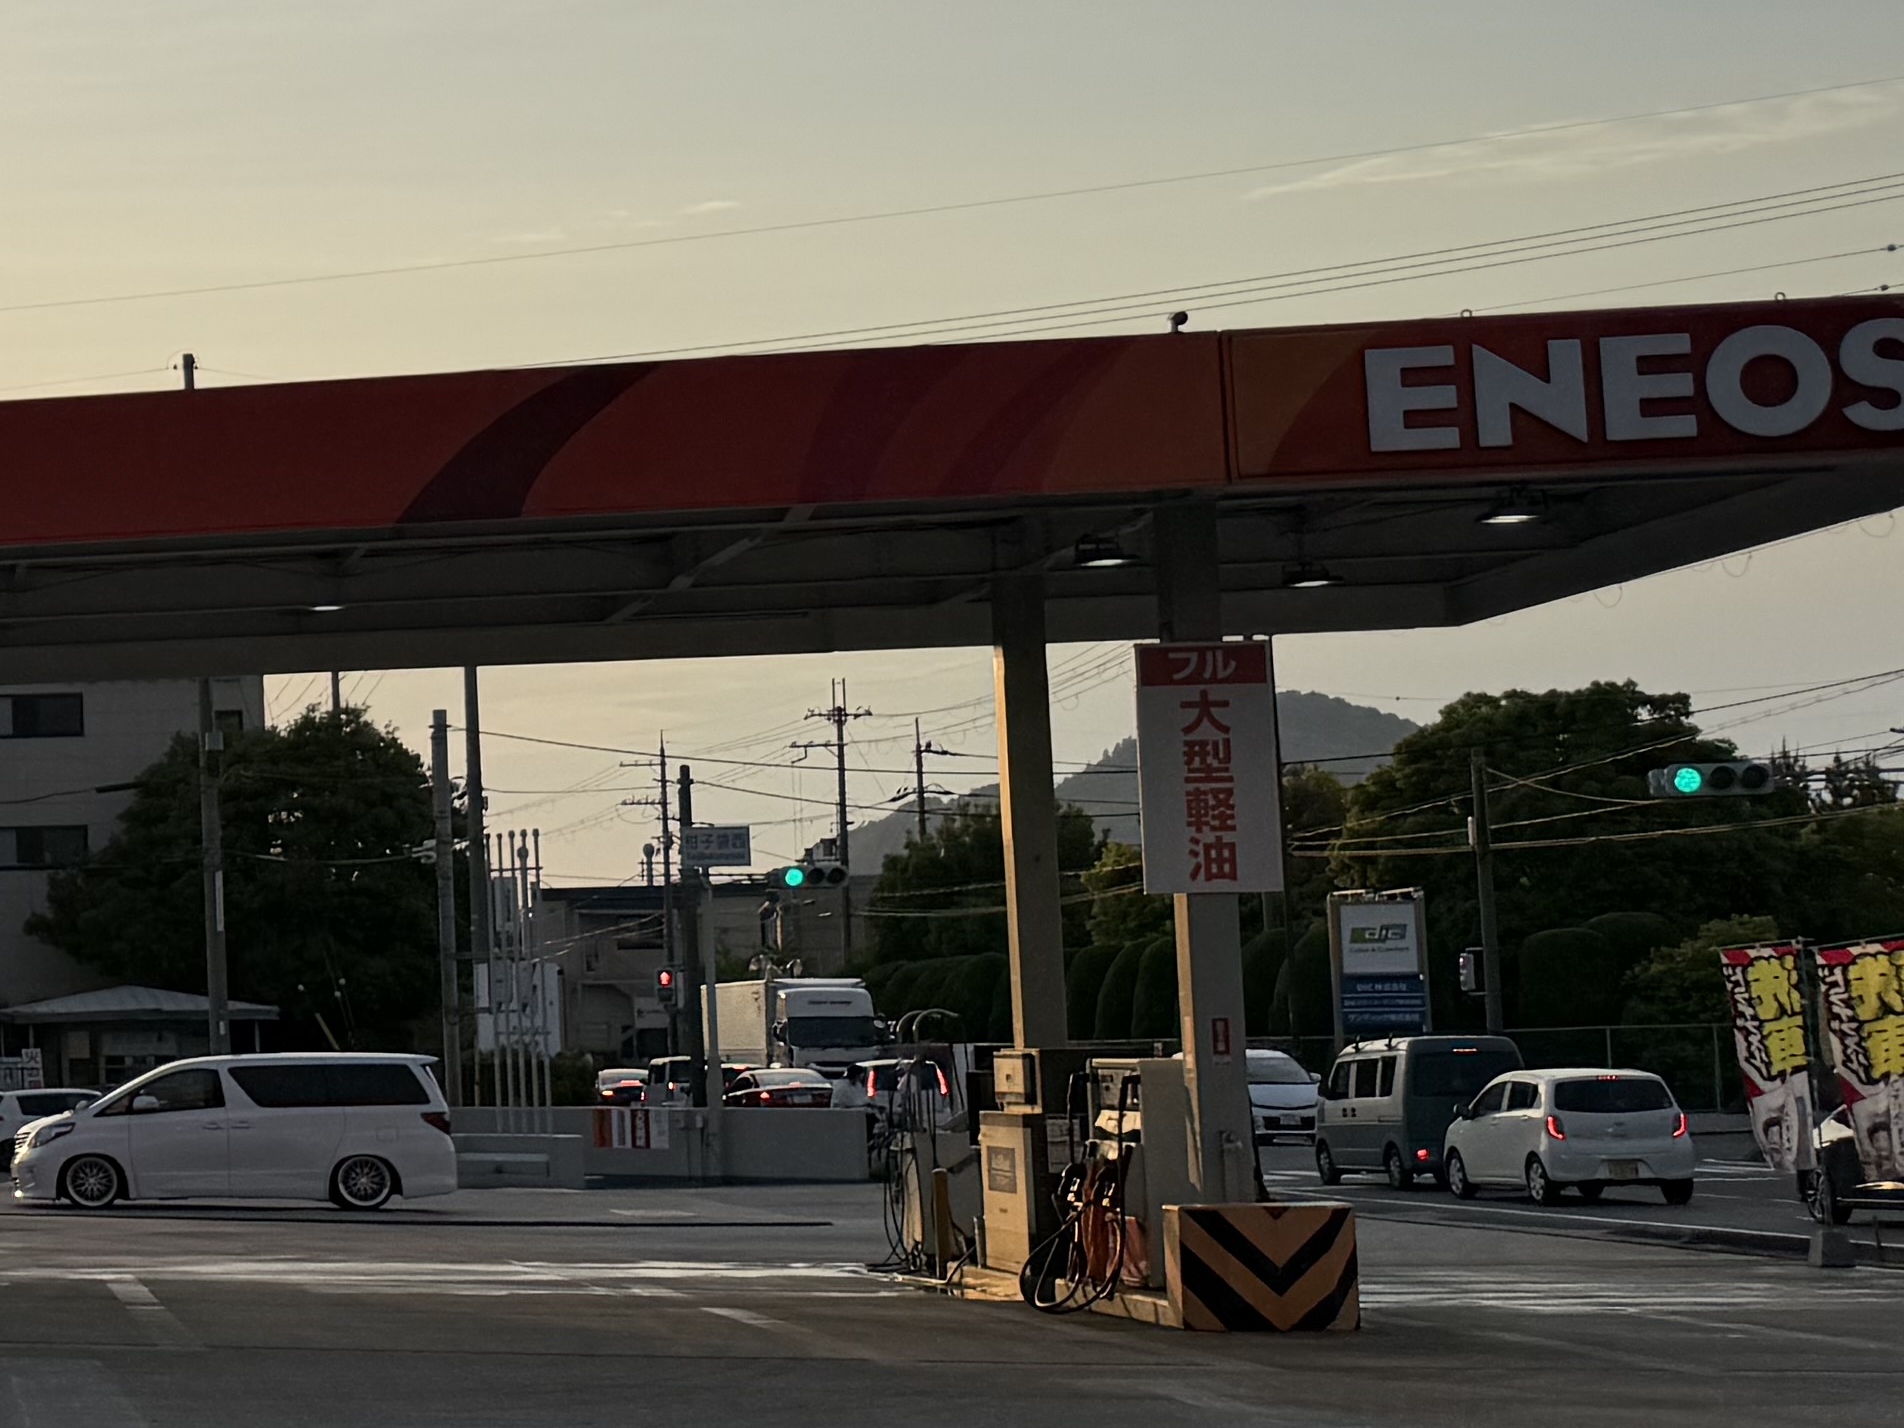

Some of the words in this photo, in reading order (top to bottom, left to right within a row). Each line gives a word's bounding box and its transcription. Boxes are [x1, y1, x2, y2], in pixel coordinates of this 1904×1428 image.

[1364, 316, 1904, 454] ENEOS
[1167, 650, 1237, 681] フル
[1179, 689, 1239, 882] 大型軽油
